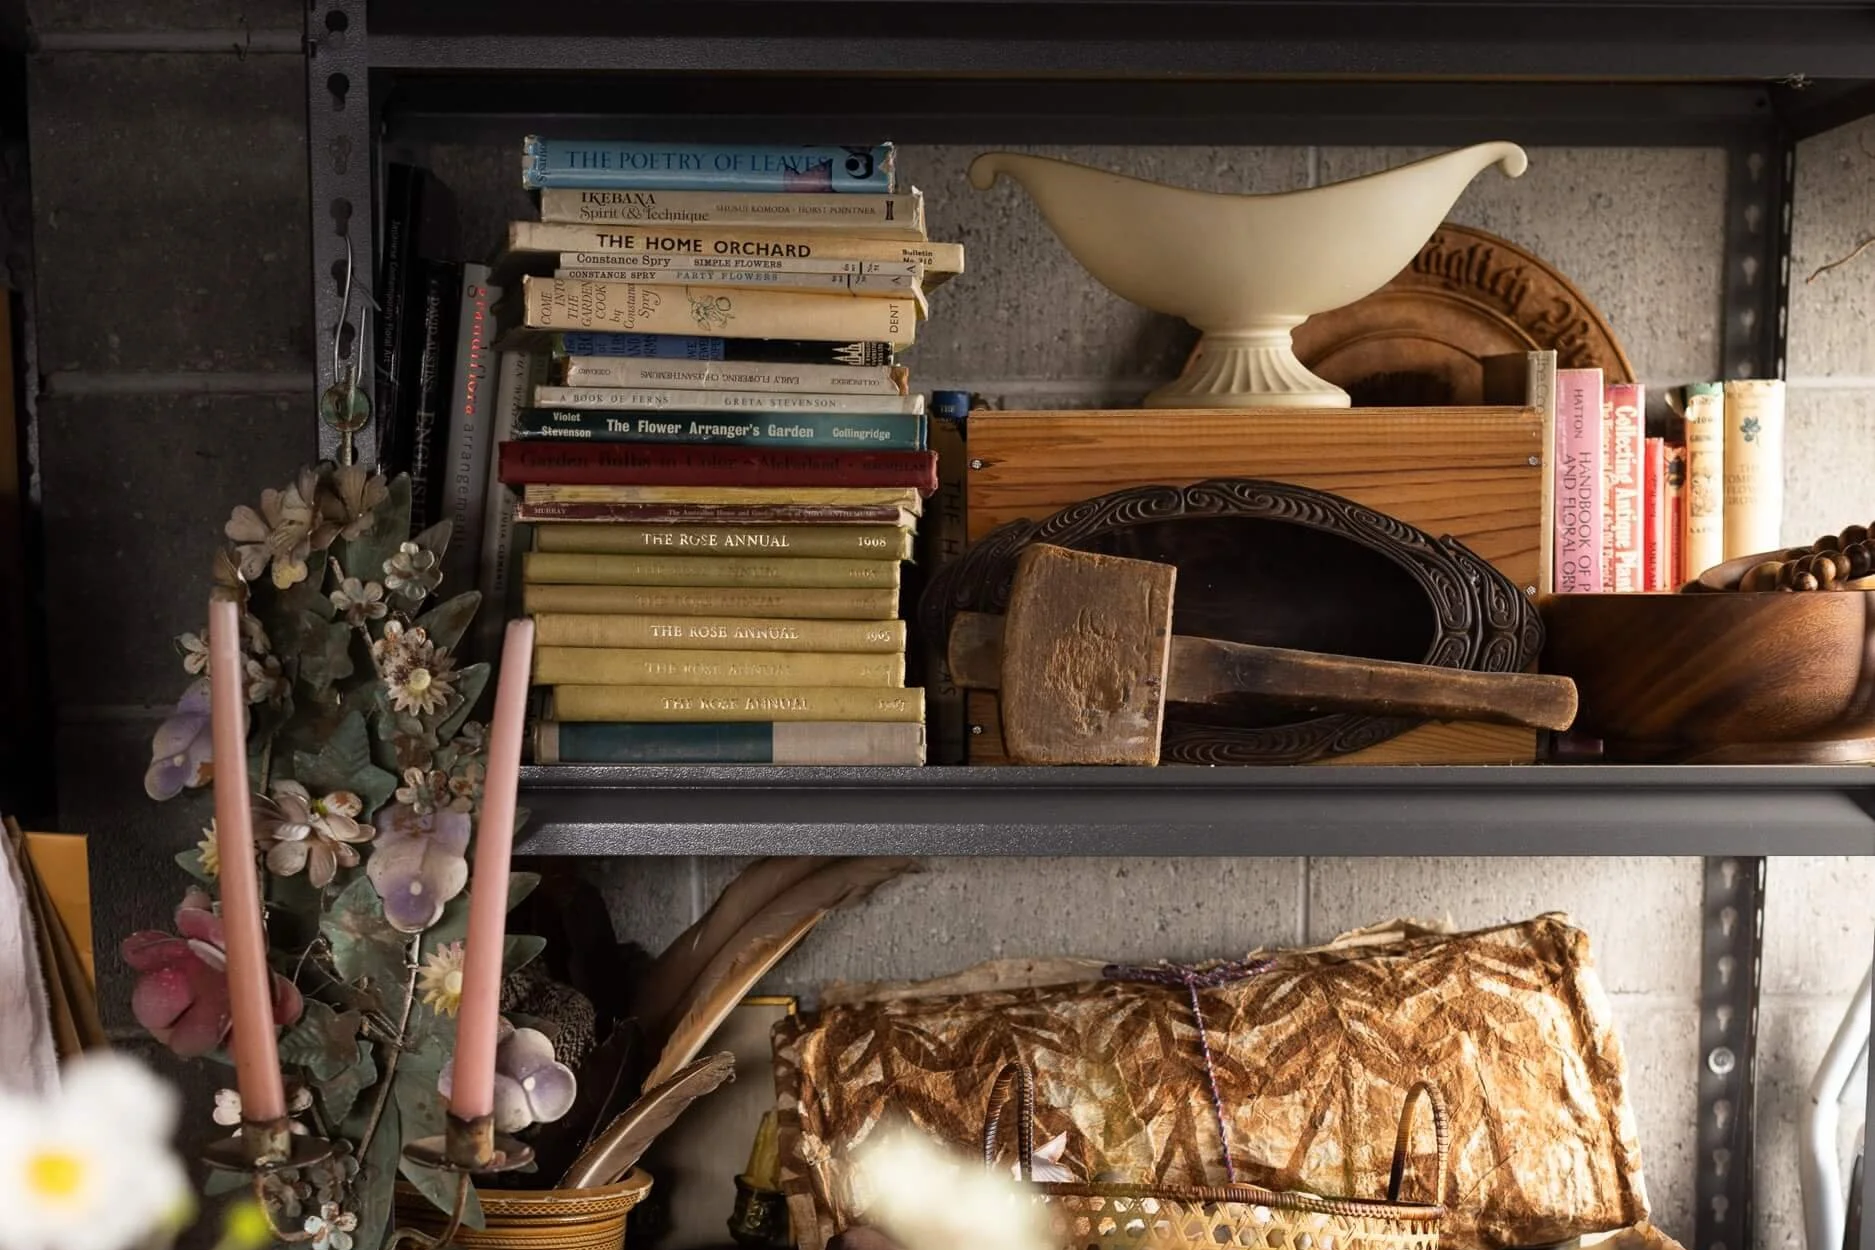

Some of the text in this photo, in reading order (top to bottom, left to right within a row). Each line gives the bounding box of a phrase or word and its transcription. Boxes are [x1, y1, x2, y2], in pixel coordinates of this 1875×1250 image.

[565, 150, 830, 173] THE POETRY OF LEAVES
[581, 192, 656, 208] IKEBANA
[579, 206, 618, 220] Spirit
[644, 206, 710, 222] Technique
[596, 234, 811, 258] THE HOME ORCHARD
[902, 249, 933, 257] Bulletin
[577, 253, 782, 269] Constance Spry SIMPLE FLOWERS
[569, 271, 778, 281] CONSTANCE SPRY PARTY FLOWERS
[554, 278, 566, 307] INTO
[581, 280, 593, 327] GARDEN
[595, 284, 607, 320] COOK
[425, 295, 441, 333] DAVID
[541, 291, 552, 325] COME
[567, 295, 578, 319] THE
[609, 309, 624, 323] by
[638, 290, 661, 320] Spry
[889, 303, 899, 333] DENT
[464, 284, 488, 416] grandiflora
[722, 374, 770, 384] FLOWERING
[775, 375, 800, 385] EARLY
[724, 398, 763, 406] GRETA
[771, 399, 837, 407] STEVENSON
[1573, 389, 1584, 439] HATTON
[553, 412, 581, 422] Violet
[541, 418, 891, 441] Stevenson The Flower Arranger's Garden Collingridge
[1563, 454, 1577, 490] AND
[1579, 452, 1591, 548] HANDBOOK
[1610, 405, 1639, 593] Collecting Antique Plant
[1563, 497, 1577, 557] FLORAL
[642, 533, 673, 545] THE
[679, 534, 718, 546] ROSE
[724, 535, 790, 547] ANNUAL
[1578, 555, 1590, 577] OF
[650, 625, 682, 637] THE
[689, 626, 727, 638] ROSE
[734, 626, 799, 639] ANNUAL
[661, 697, 692, 710] THE
[700, 698, 738, 710] ROSE
[744, 697, 808, 711] ANNUAL
